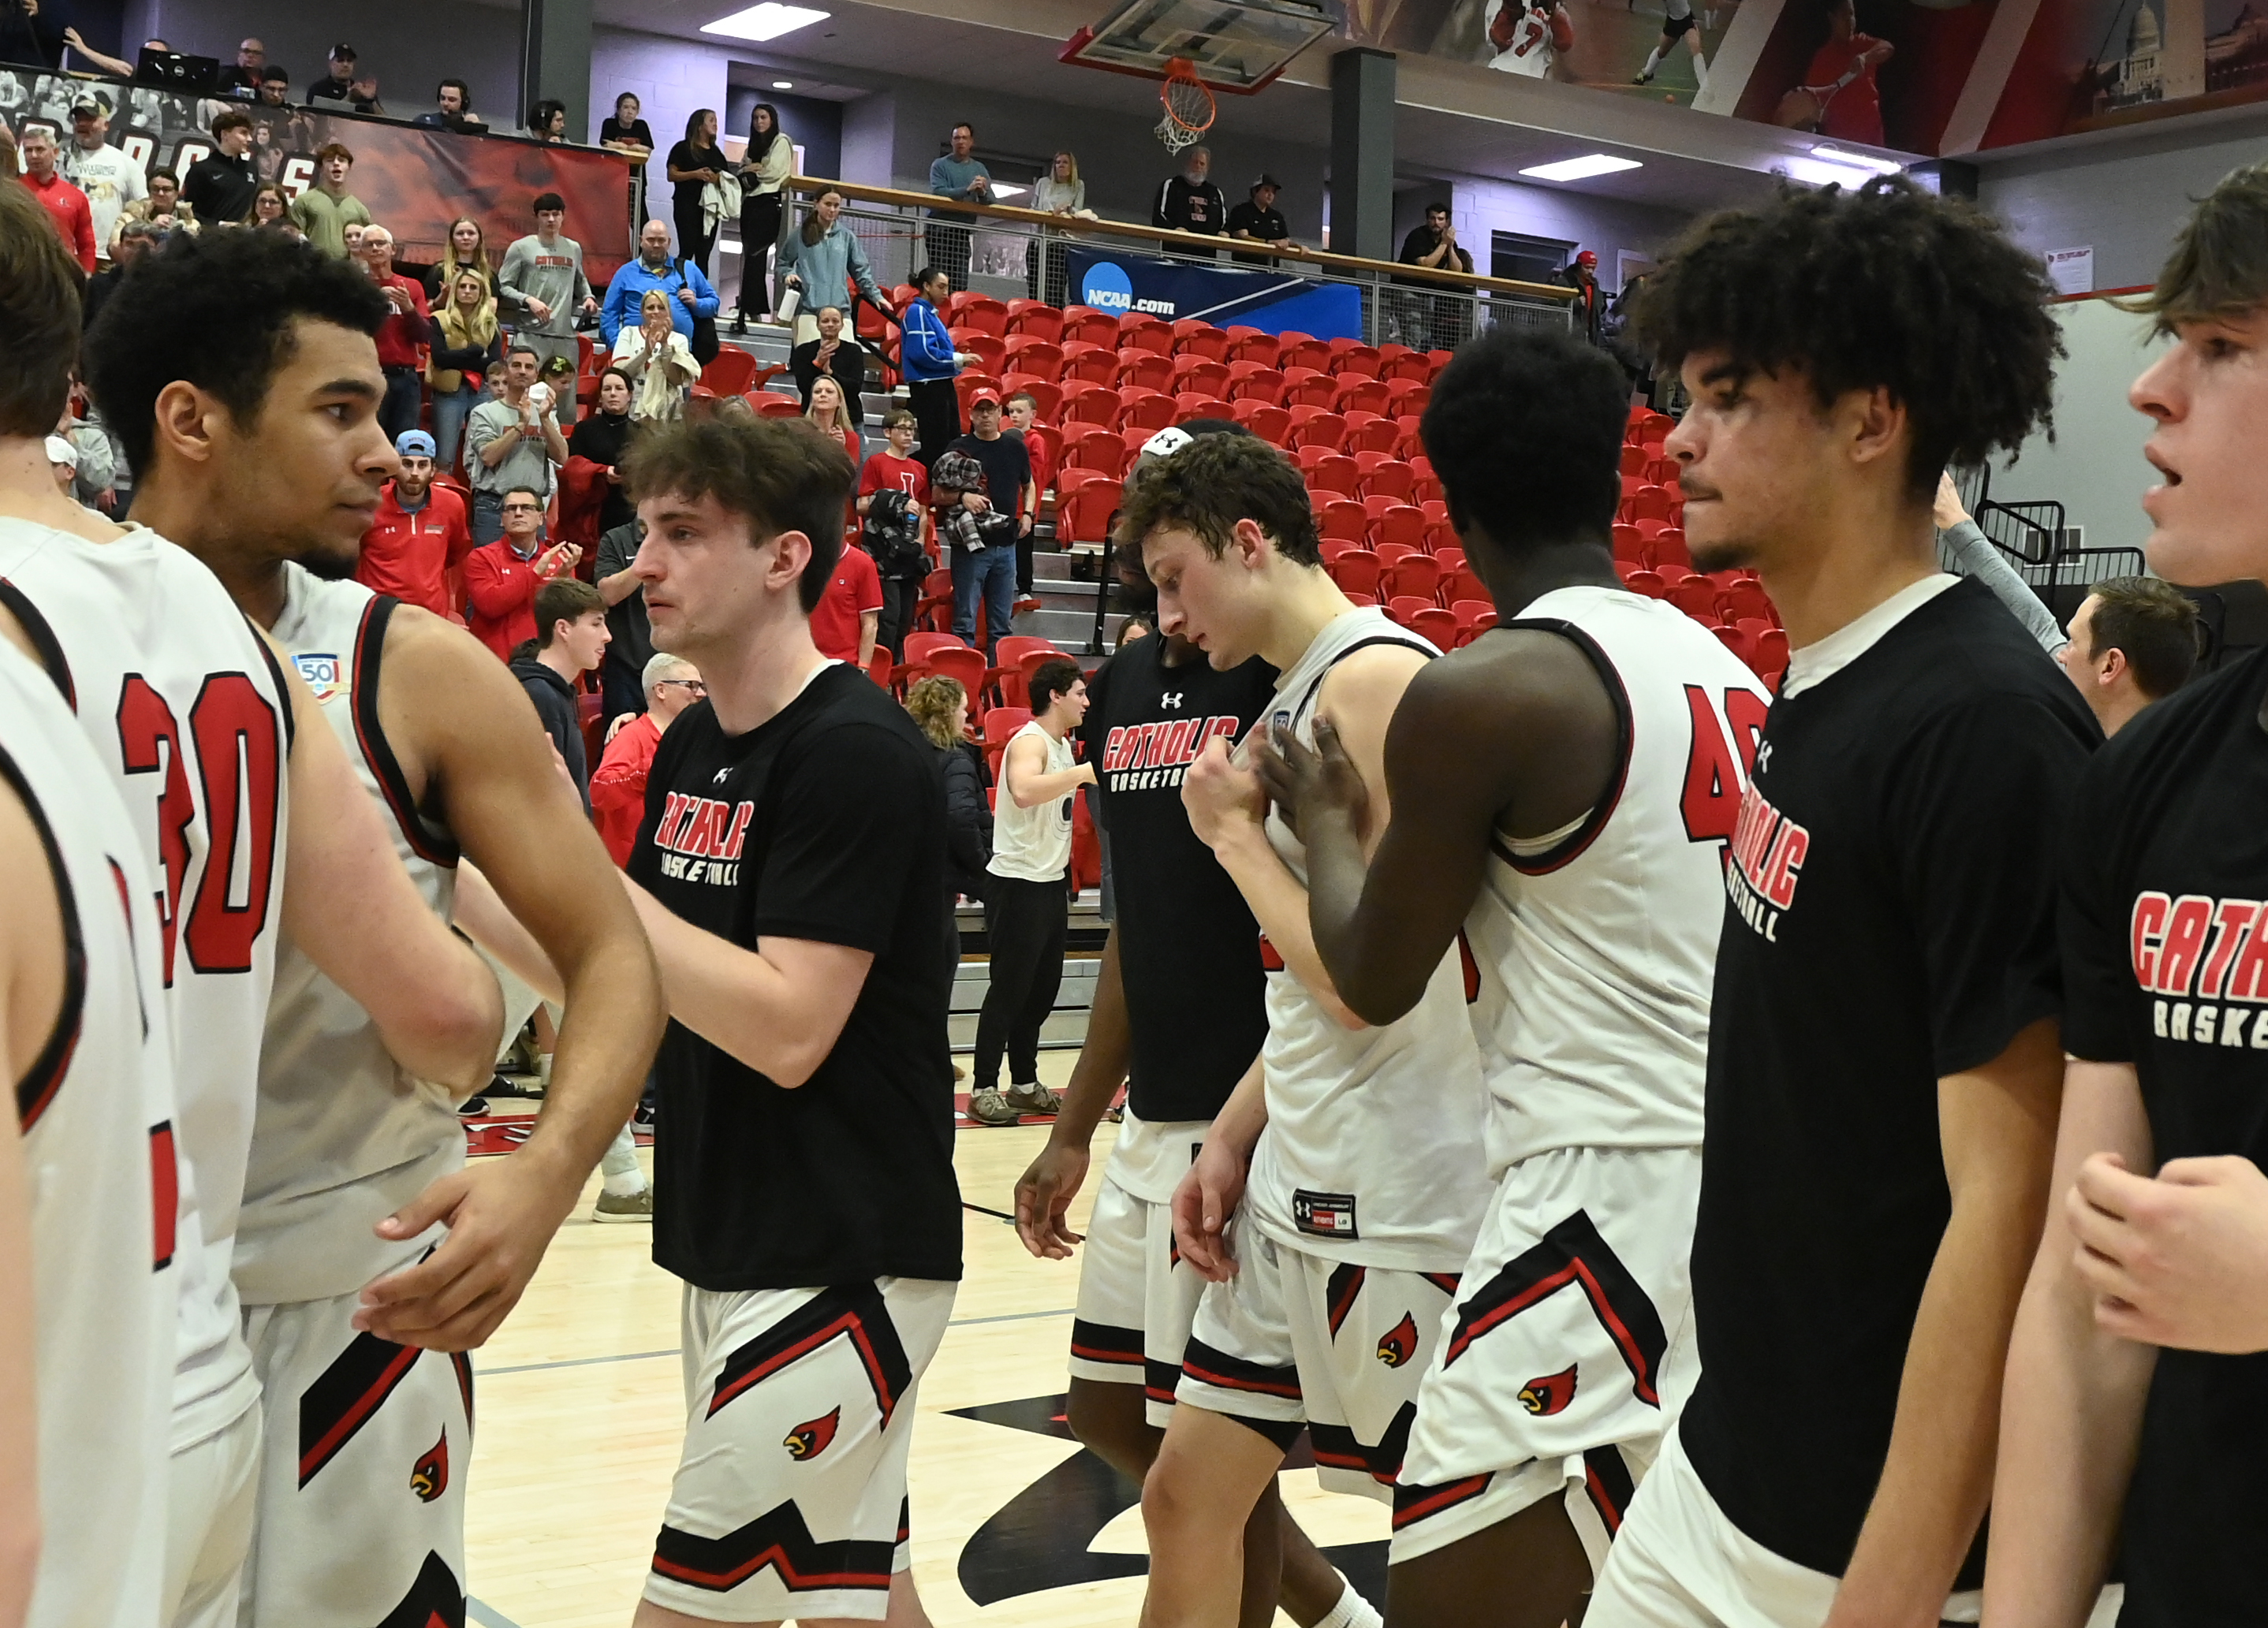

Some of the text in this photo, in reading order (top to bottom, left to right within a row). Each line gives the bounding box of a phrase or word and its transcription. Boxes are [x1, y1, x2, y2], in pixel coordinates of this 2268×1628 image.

[301, 663, 333, 683] 50
[1110, 766, 1190, 792] BASKETB
[116, 671, 280, 989] 30
